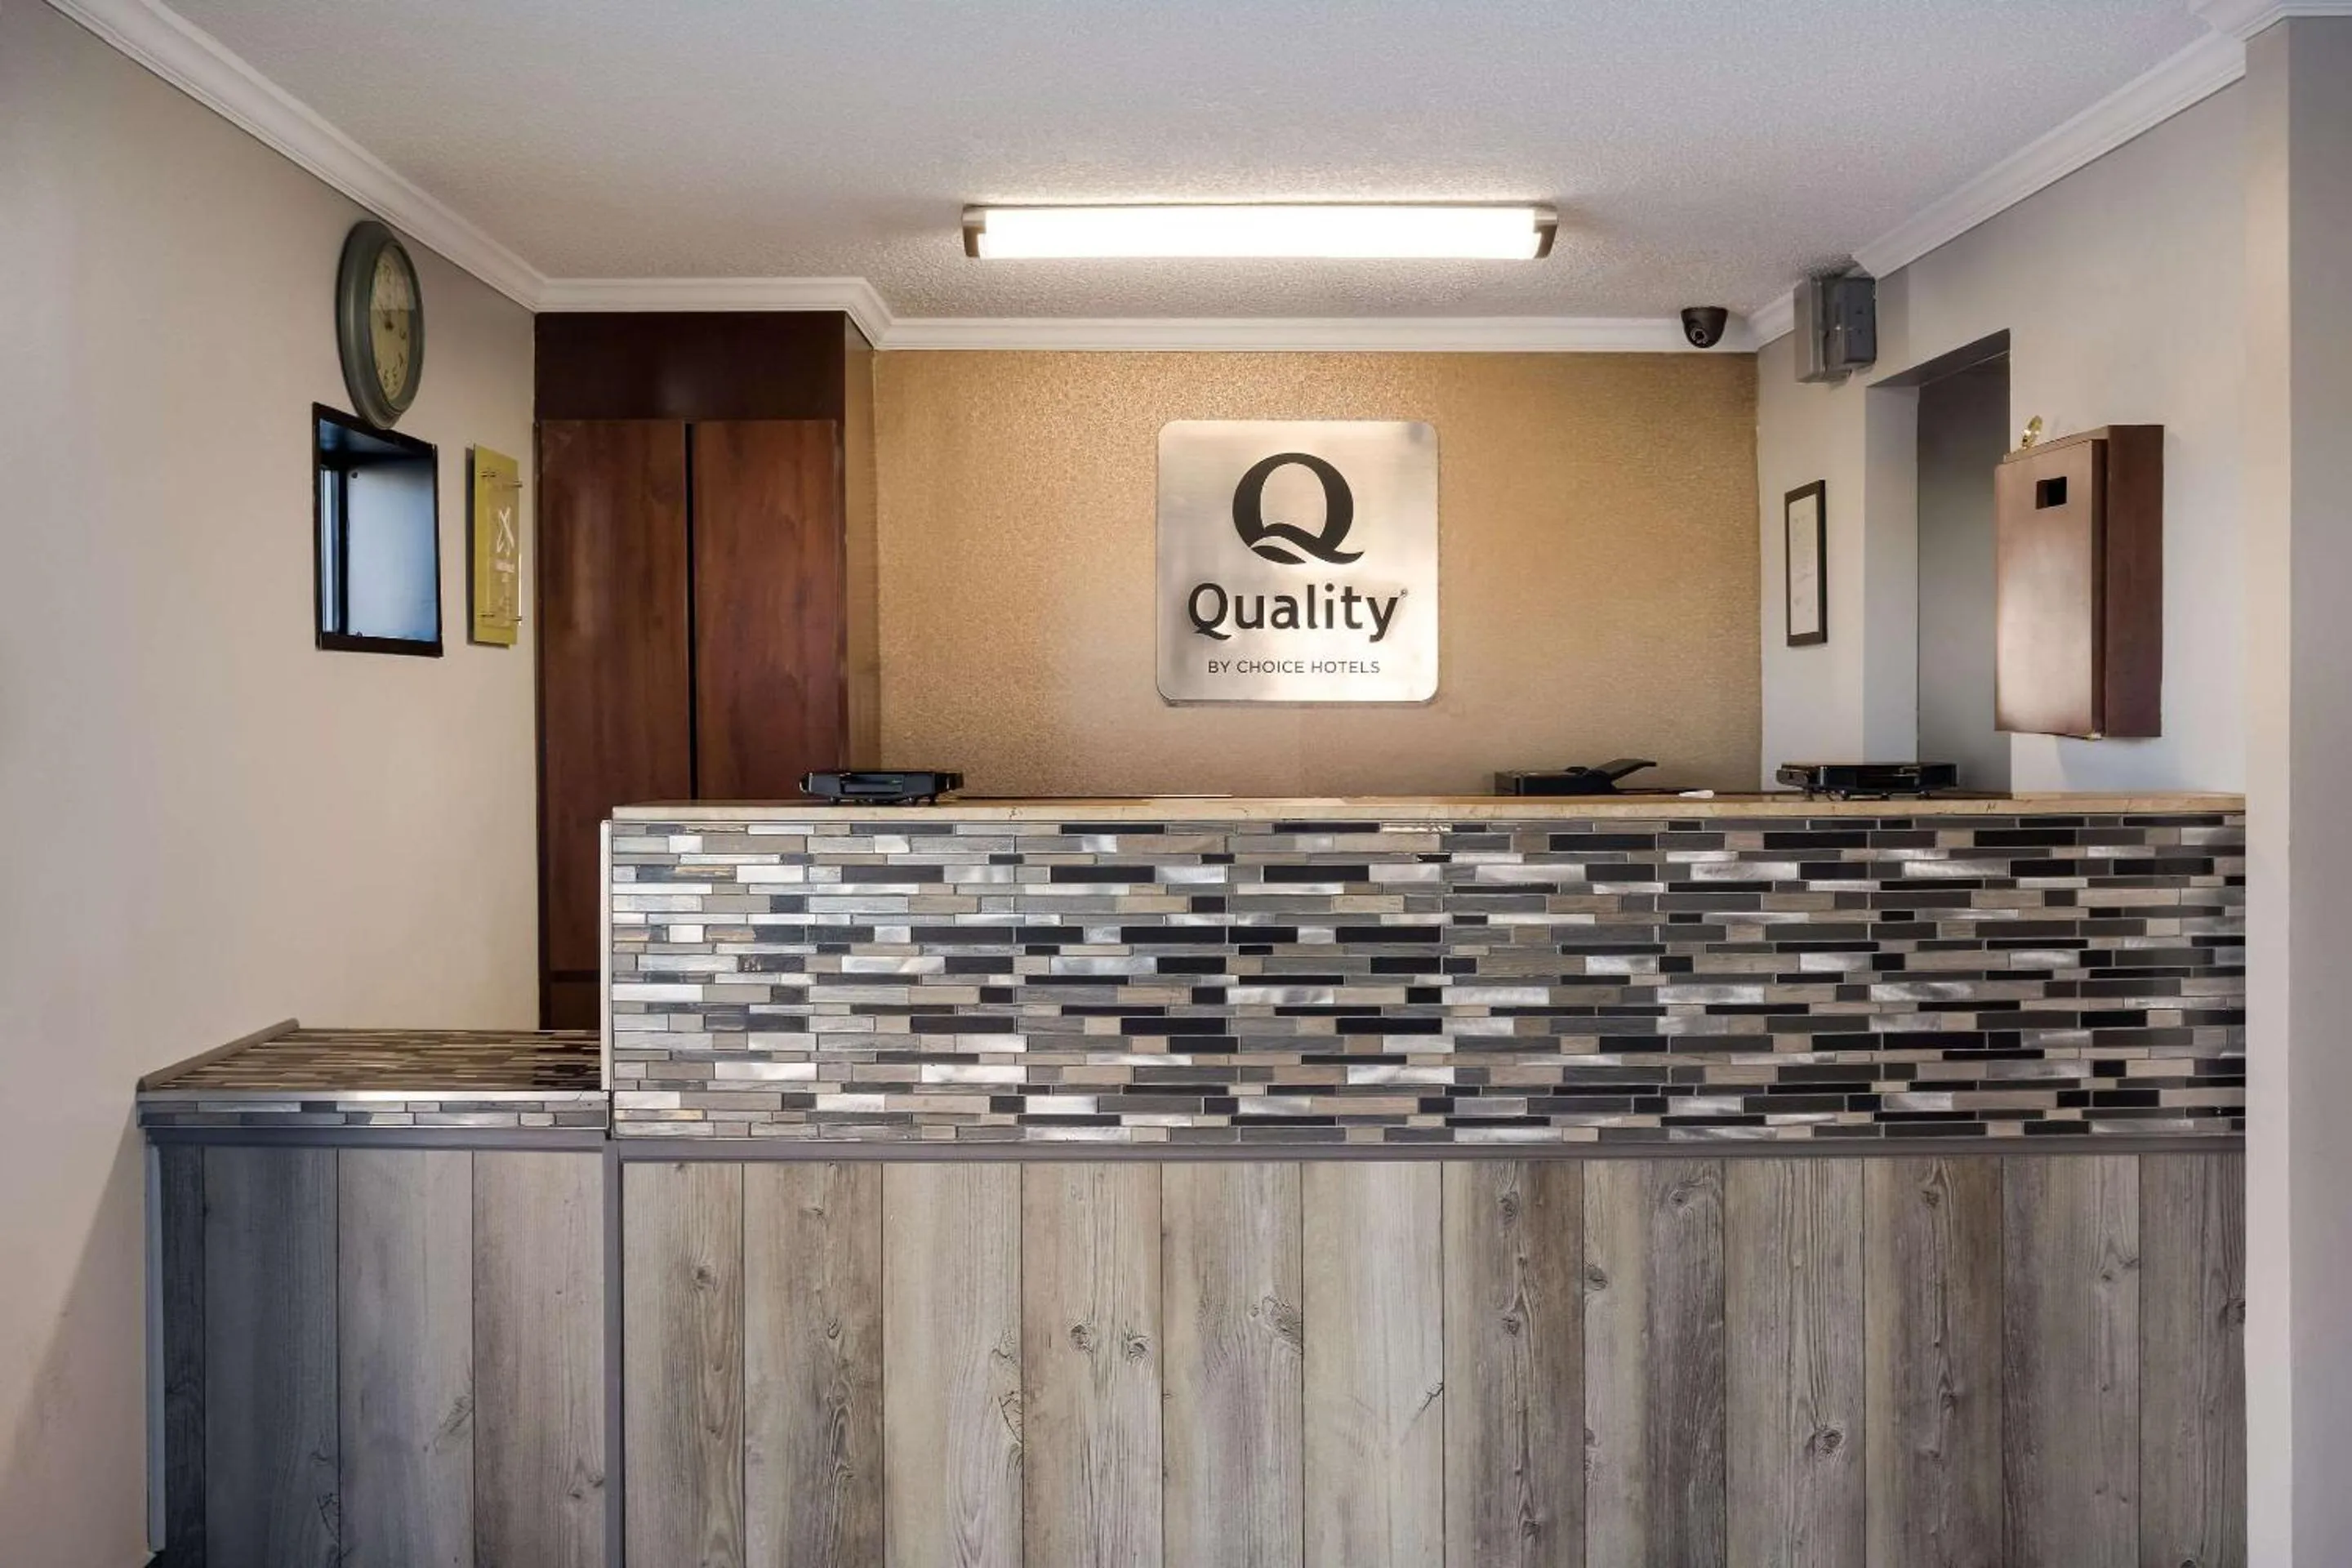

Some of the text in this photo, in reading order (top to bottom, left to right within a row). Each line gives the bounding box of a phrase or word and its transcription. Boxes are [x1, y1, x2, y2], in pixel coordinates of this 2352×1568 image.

[1232, 452, 1365, 564] Q
[1188, 582, 1399, 643] Quality
[1208, 661, 1381, 674] BY CHOICE HOTELS
